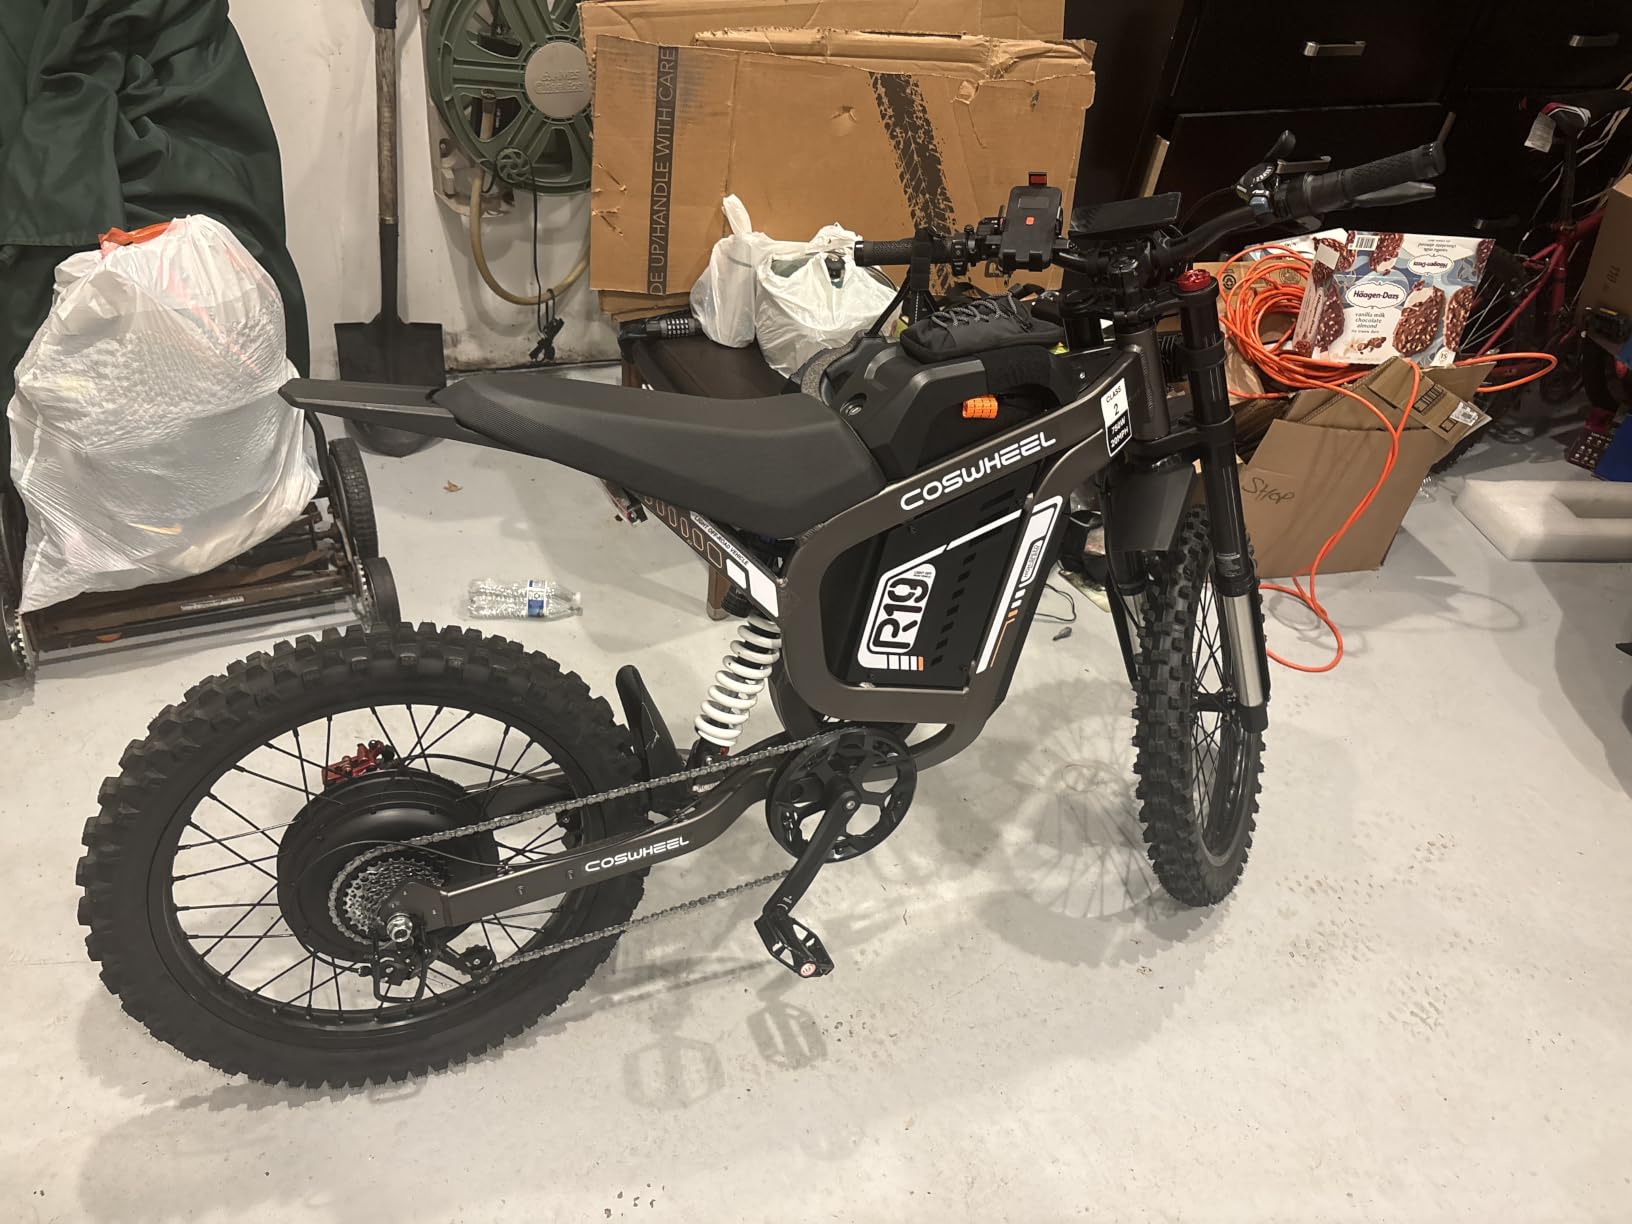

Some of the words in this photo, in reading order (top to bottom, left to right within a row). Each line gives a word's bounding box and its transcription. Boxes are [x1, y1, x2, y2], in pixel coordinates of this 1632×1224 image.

[658, 48, 676, 101] CARE
[656, 107, 672, 157] WITH
[651, 161, 669, 267] UP/HANDLE
[1353, 290, 1399, 300] Häagen-Dazs
[1106, 385, 1122, 403] CLASS
[1113, 403, 1120, 416] 2
[1110, 426, 1129, 448] 20MPH
[900, 432, 1056, 510] COSWHEEL
[694, 515, 709, 529] LIGHT
[730, 547, 749, 565] VEHICLE
[872, 578, 929, 650] R19
[585, 836, 689, 872] COSWHEEL
